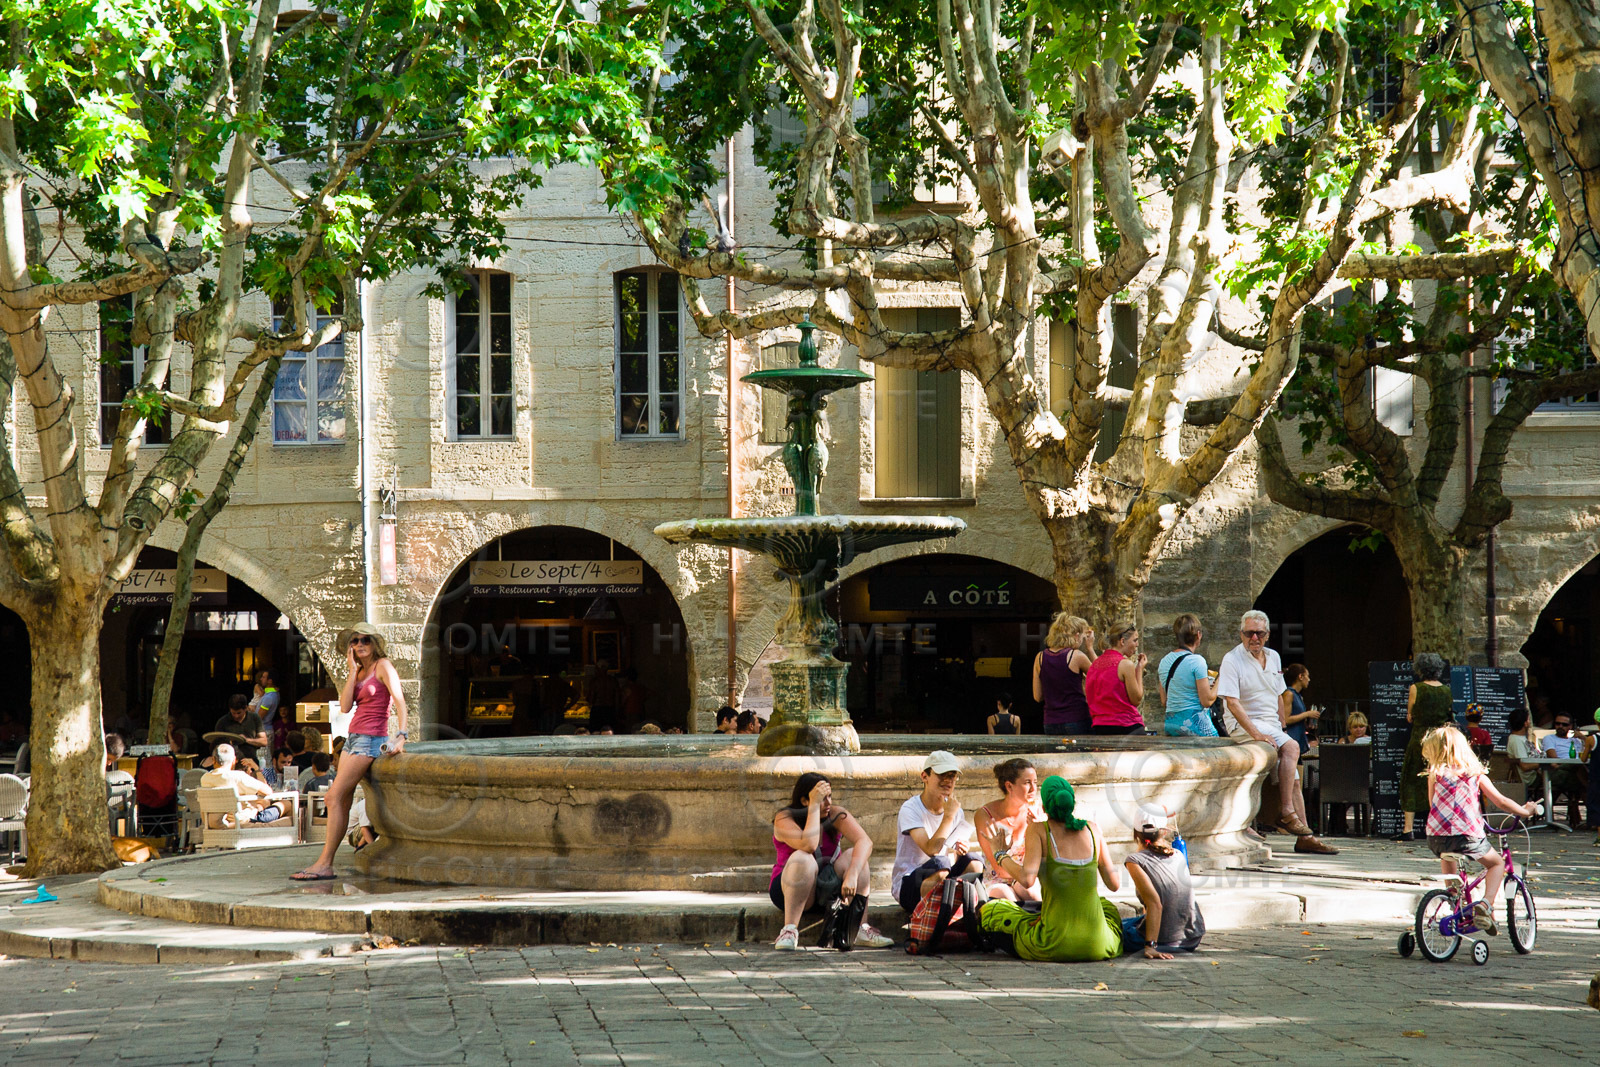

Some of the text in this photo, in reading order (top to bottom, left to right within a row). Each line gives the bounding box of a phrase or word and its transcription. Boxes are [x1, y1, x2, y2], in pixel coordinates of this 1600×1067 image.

[120, 570, 167, 592] pt/4
[510, 561, 602, 583] Le Sept/4
[116, 594, 159, 606] Pizzeria
[473, 585, 639, 596] Bar Restaurant Pizzeria Glacier
[923, 581, 1010, 605] A CÔTÉ
